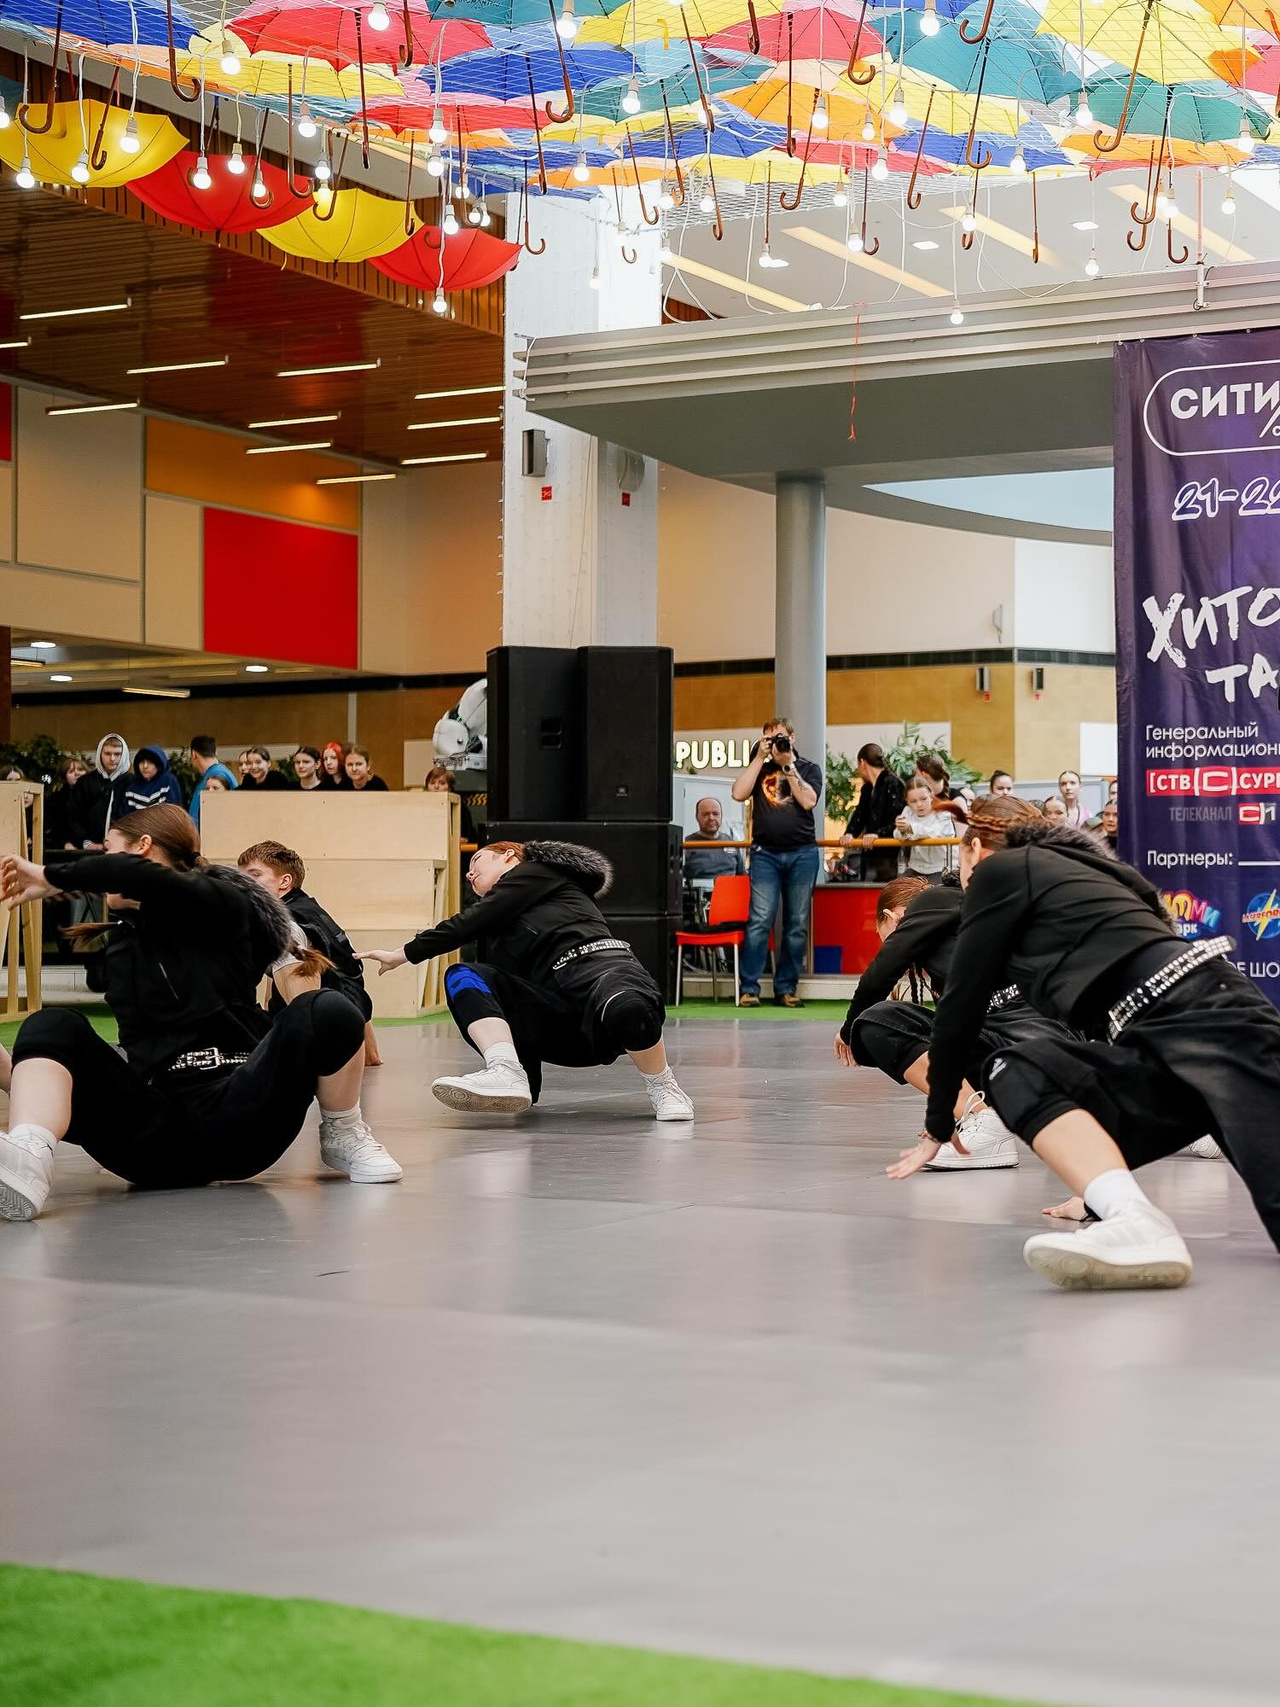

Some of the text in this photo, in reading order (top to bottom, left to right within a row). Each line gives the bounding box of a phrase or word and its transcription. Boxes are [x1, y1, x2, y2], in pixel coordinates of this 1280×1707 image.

[1170, 381, 1280, 420] СИТИ
[1145, 721, 1259, 743] Генеральный
[676, 739, 758, 769] PUBLI
[1170, 806, 1232, 822] ТЕЛЕКАНАЛ
[1147, 850, 1234, 869] Партнеры:
[1172, 923, 1198, 937] арк
